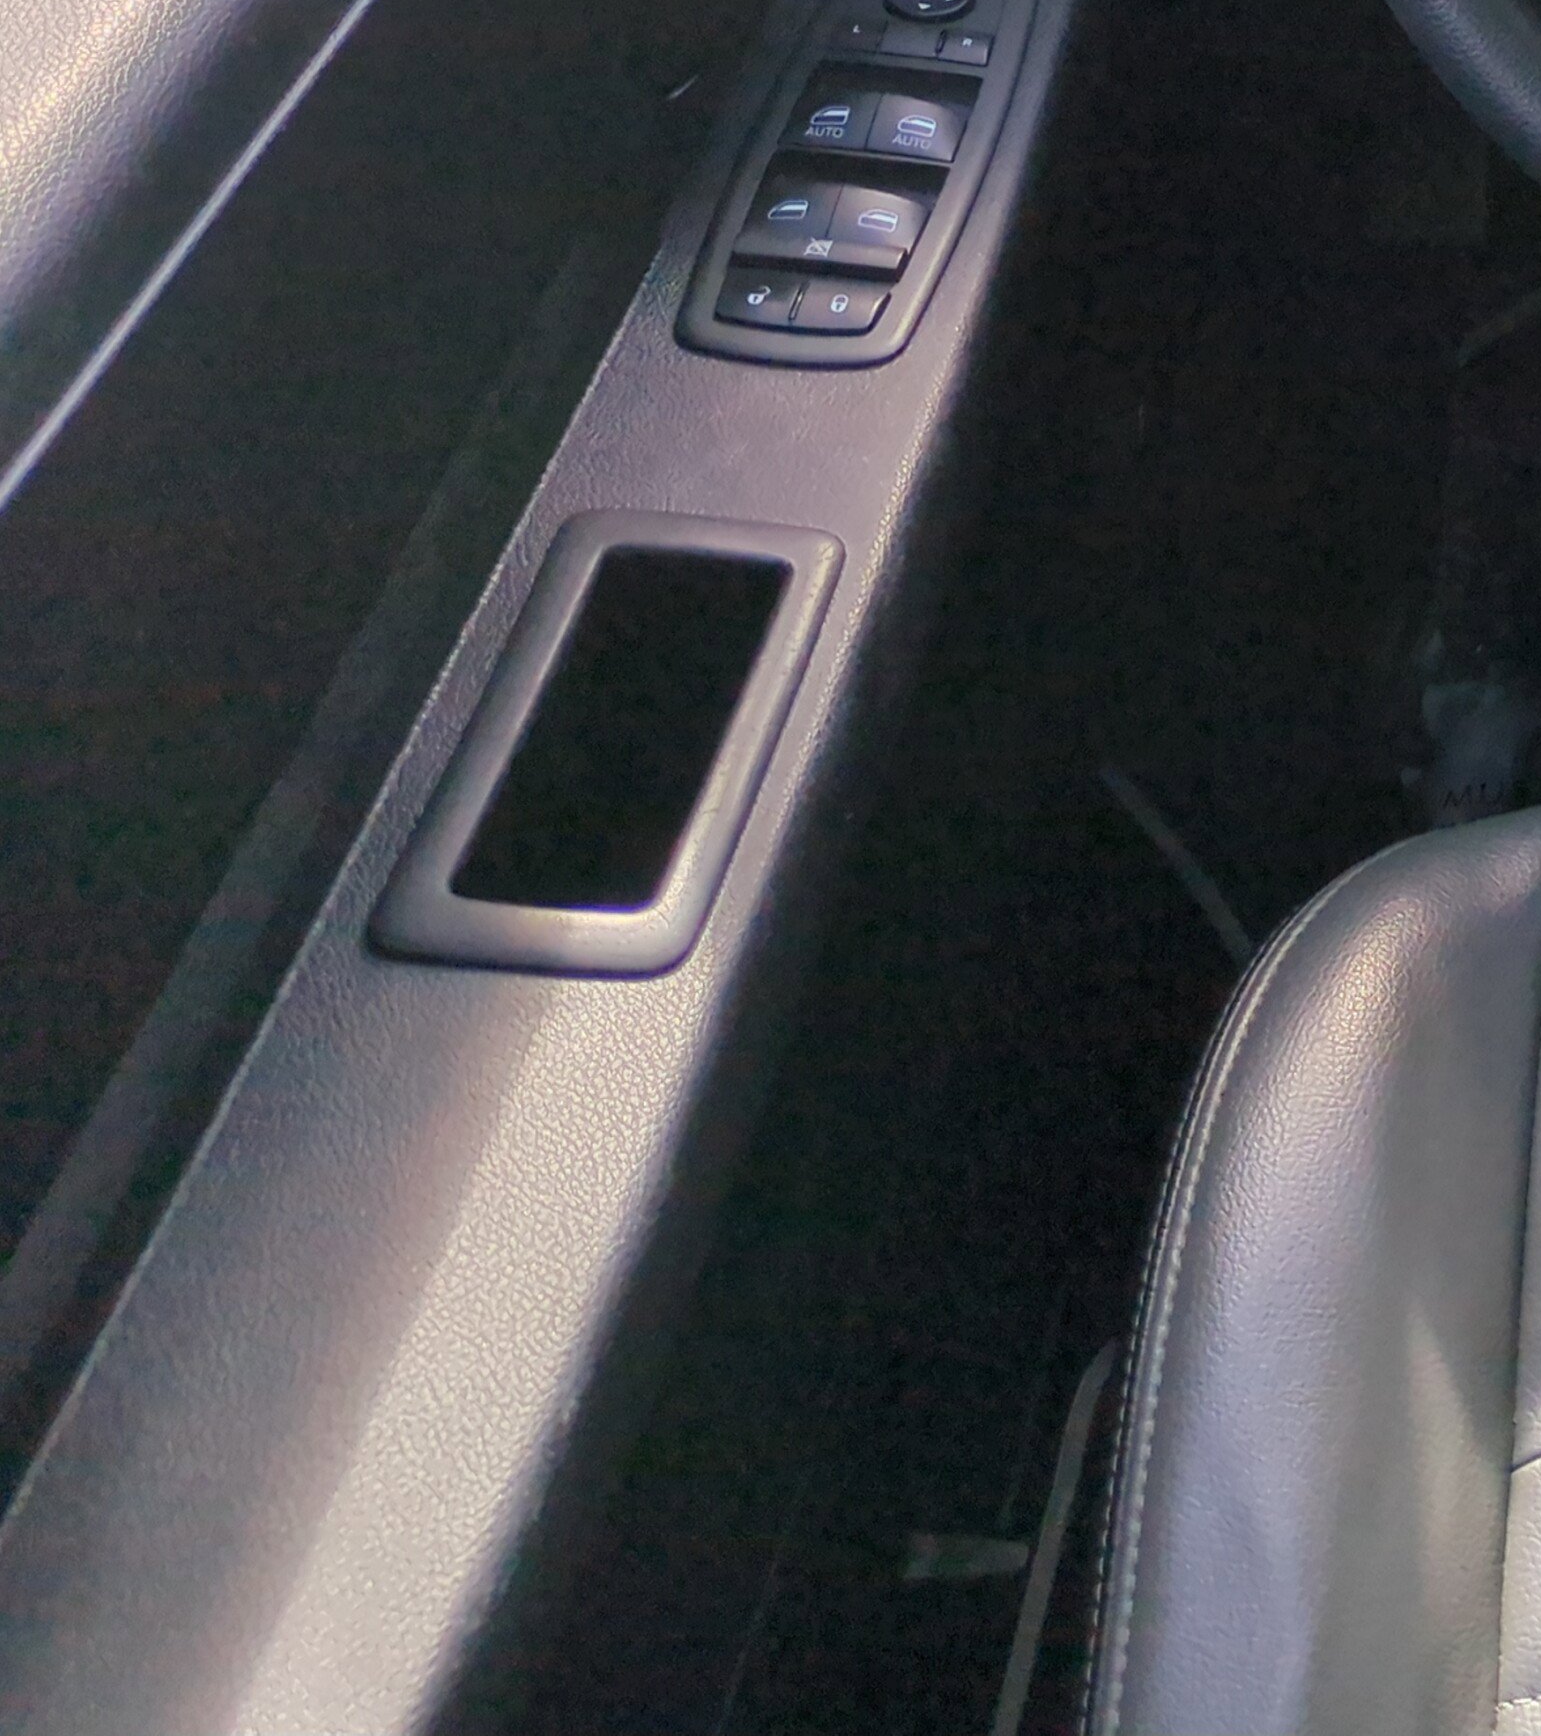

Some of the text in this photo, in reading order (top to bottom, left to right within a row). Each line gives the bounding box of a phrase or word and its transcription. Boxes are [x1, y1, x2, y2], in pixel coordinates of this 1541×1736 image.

[962, 38, 973, 46] R
[805, 126, 845, 139] AUTO
[892, 134, 931, 150] AUTO
